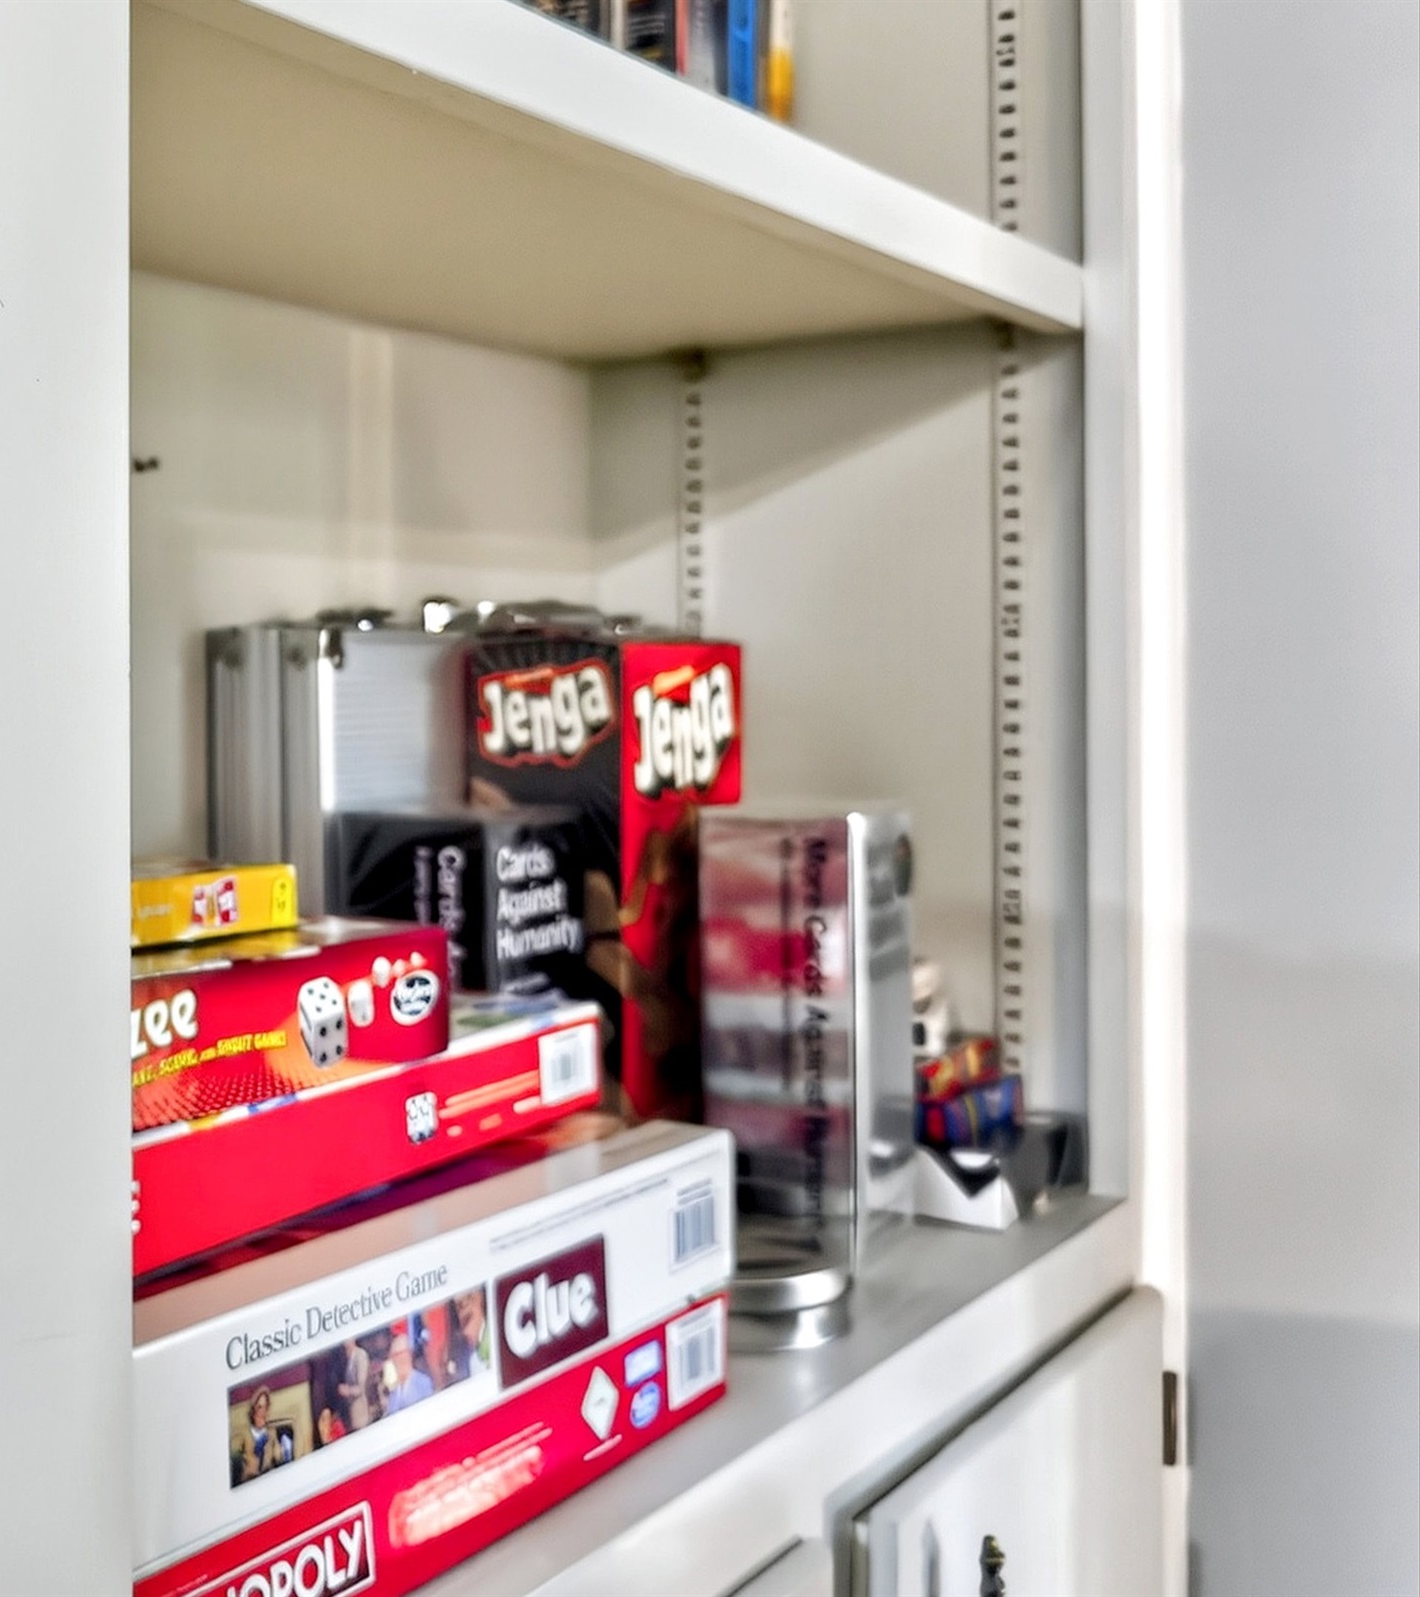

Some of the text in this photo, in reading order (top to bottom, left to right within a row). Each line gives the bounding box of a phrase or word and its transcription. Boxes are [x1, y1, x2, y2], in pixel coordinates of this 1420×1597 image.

[482, 666, 612, 756] Jenga
[633, 662, 734, 795] Jenga
[496, 845, 556, 882] Cards
[496, 878, 569, 928] Against
[496, 913, 585, 961] Humanity
[225, 1262, 449, 1372] Classic Detective Game
[503, 1272, 600, 1360] Clue
